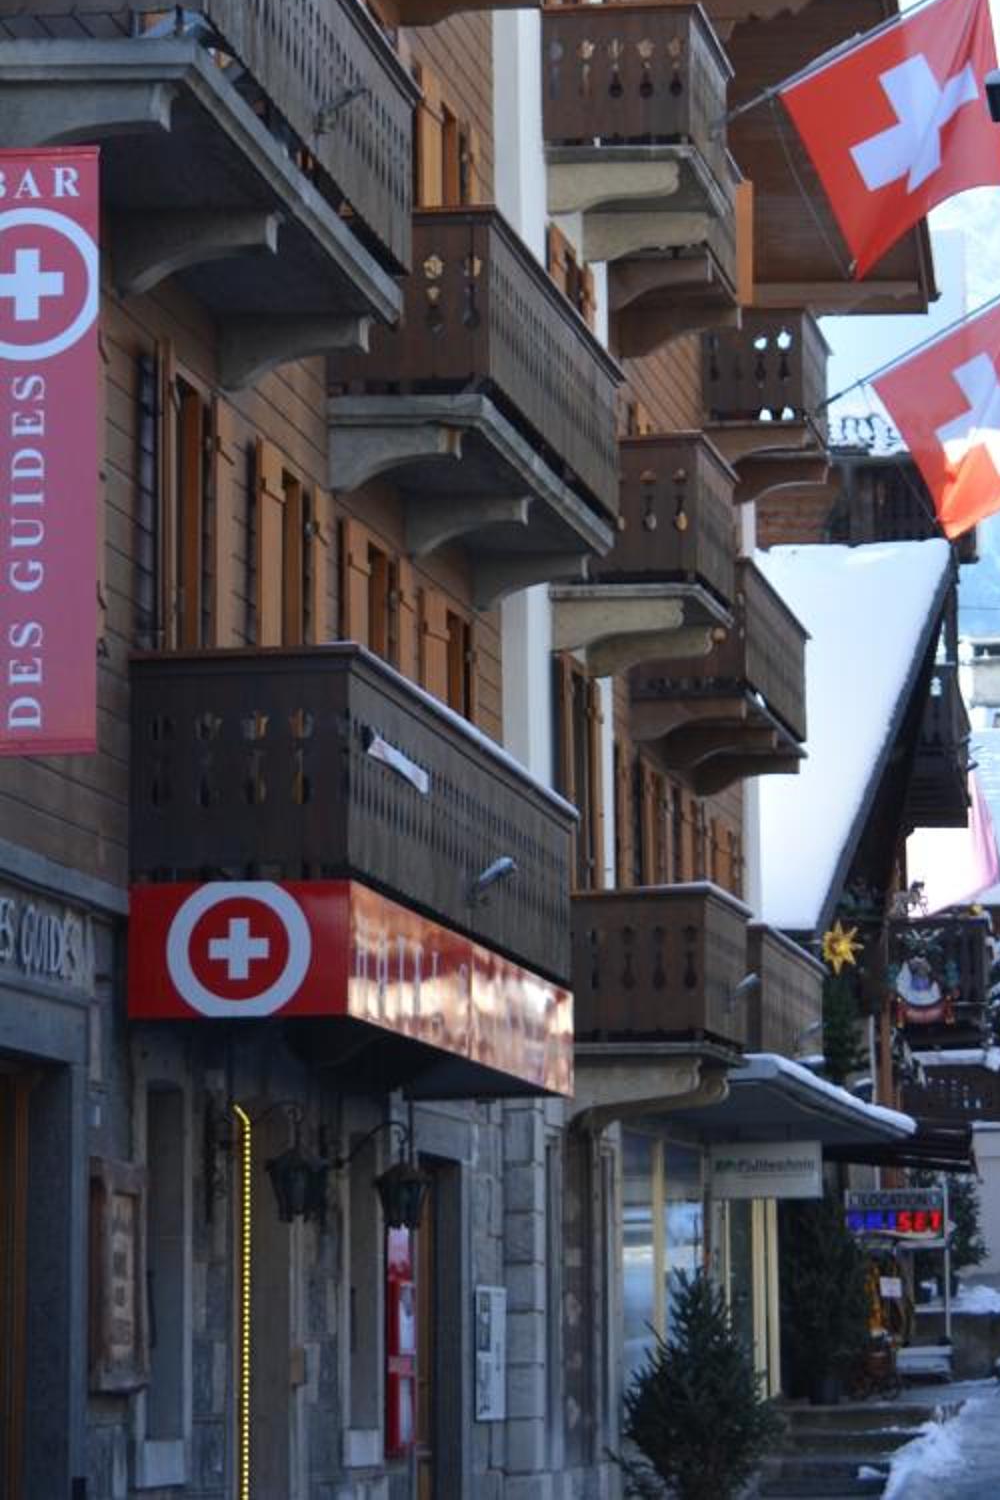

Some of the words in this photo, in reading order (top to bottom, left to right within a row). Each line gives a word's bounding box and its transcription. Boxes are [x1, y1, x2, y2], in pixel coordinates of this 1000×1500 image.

[0, 166, 80, 199] AR
[9, 374, 45, 593] GUIDES
[8, 621, 43, 730] DES
